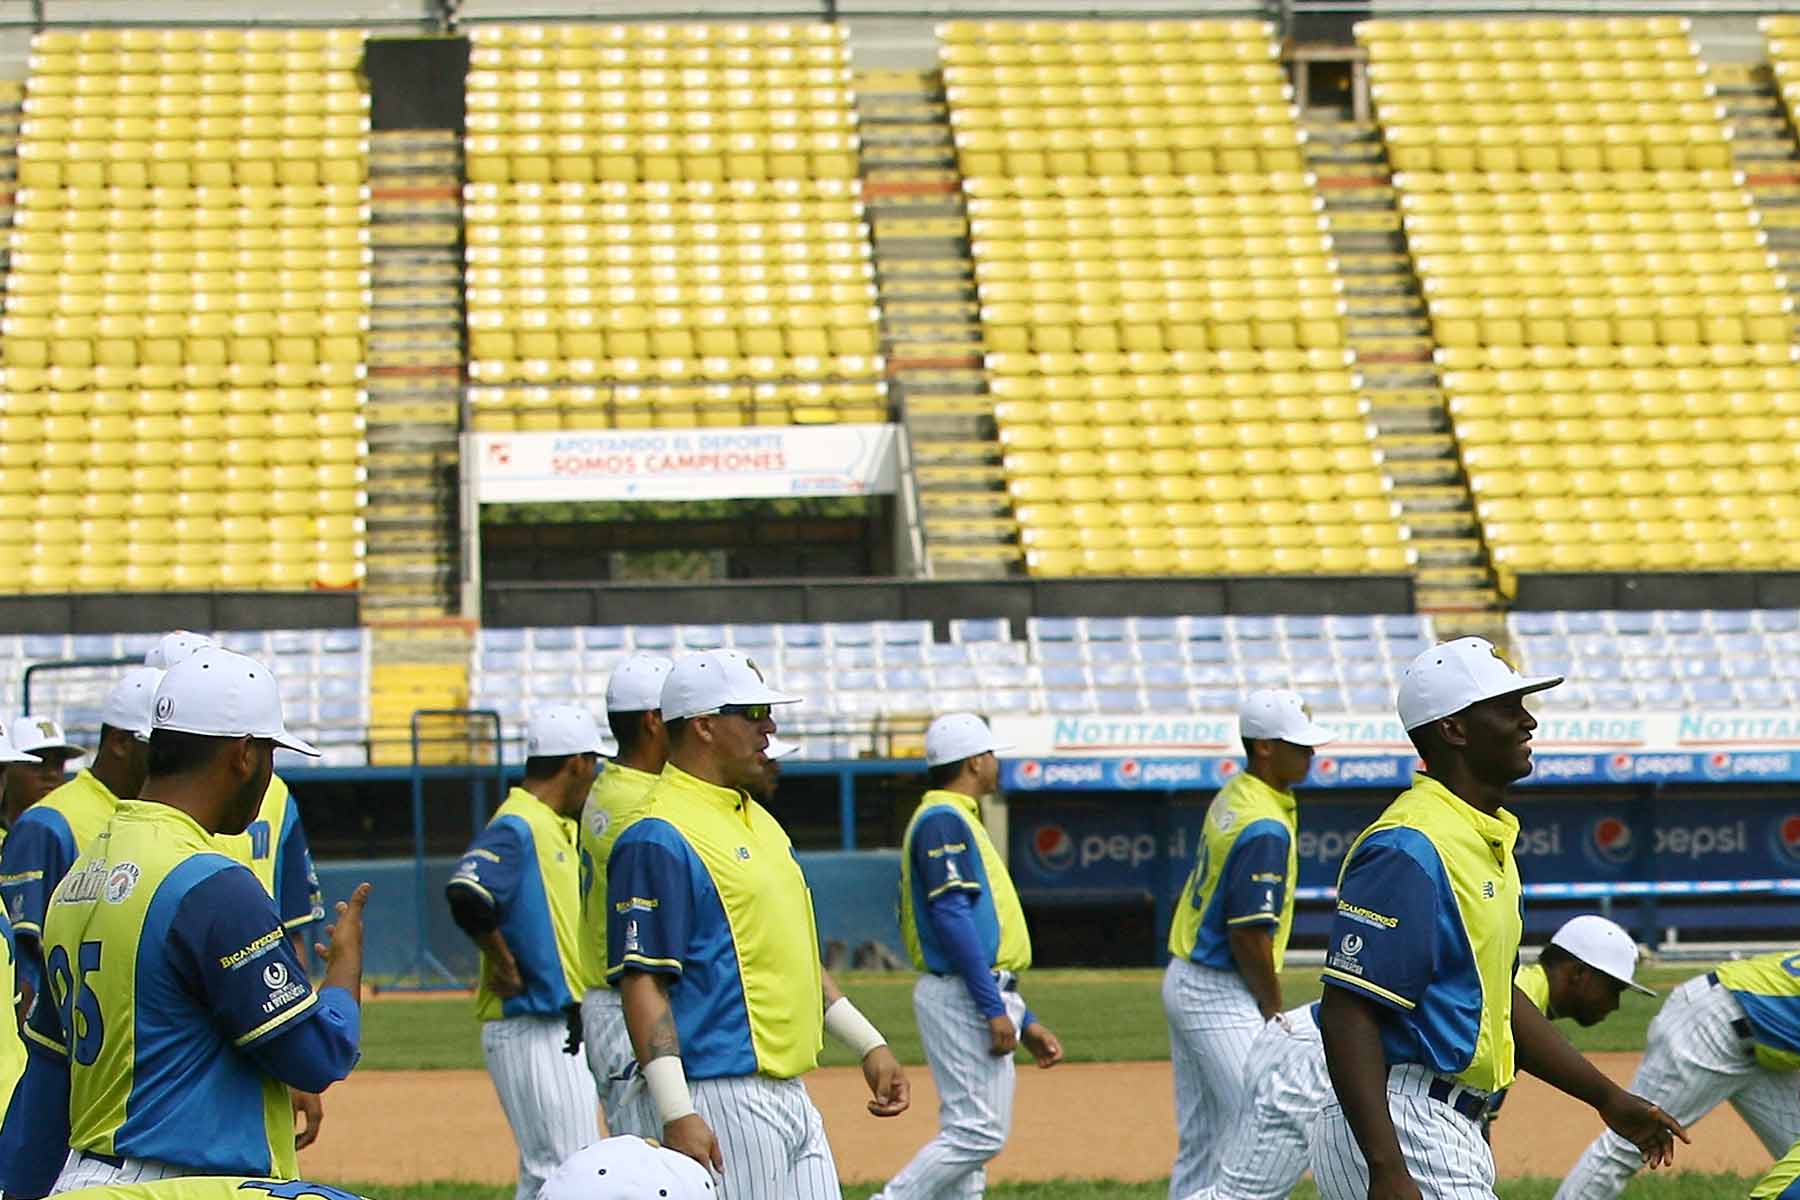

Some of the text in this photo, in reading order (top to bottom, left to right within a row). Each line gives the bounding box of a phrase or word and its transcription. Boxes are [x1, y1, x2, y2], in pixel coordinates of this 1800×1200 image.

[551, 451, 787, 475] SOMOS CAMPEONES
[1054, 716, 1233, 744] NOTITARDE
[1539, 718, 1646, 740] ITARDE
